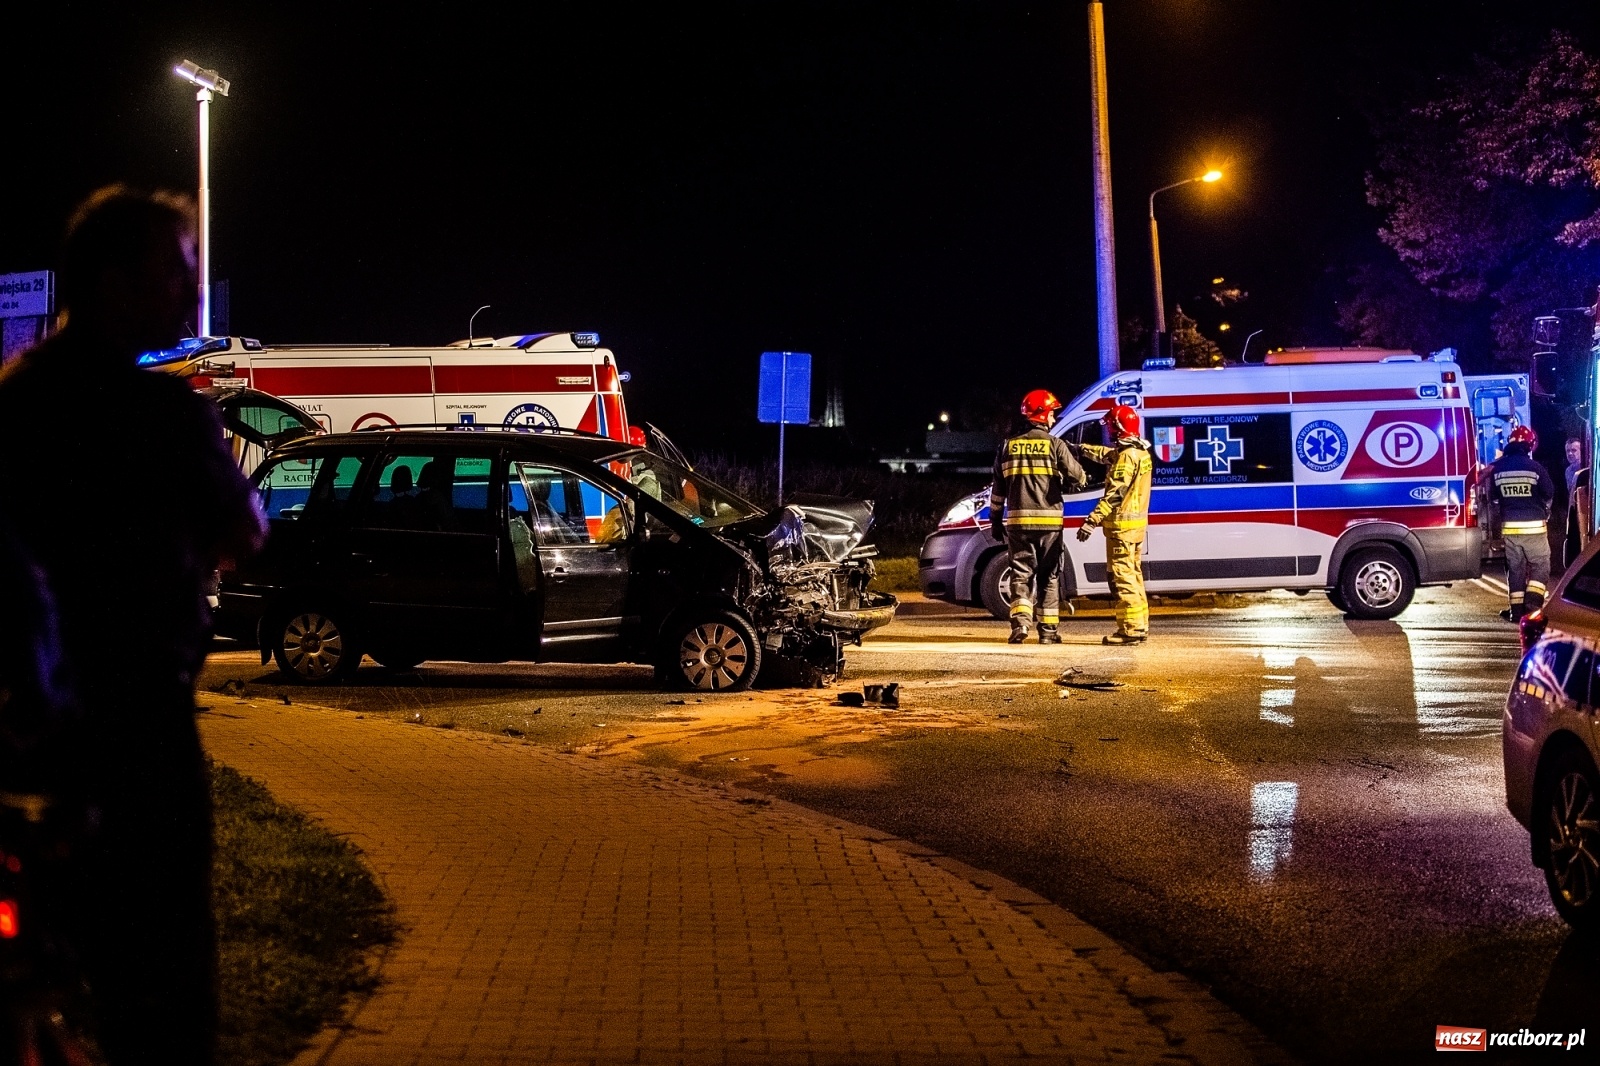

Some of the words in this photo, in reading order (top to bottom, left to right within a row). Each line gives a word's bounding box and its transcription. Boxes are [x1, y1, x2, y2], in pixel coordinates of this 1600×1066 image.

[33, 278, 44, 292] 29
[298, 404, 323, 412] WIAT
[1181, 417, 1213, 425] SZPITAL
[1214, 415, 1259, 424] REJONOWY
[1322, 421, 1347, 457] RATOWNICTWO
[1012, 440, 1046, 453] STRAŻ
[1394, 432, 1414, 458] P
[1156, 467, 1184, 475] POWIAT
[1306, 460, 1340, 471] MEDYCZNE
[1202, 474, 1248, 483] RACIBORZU
